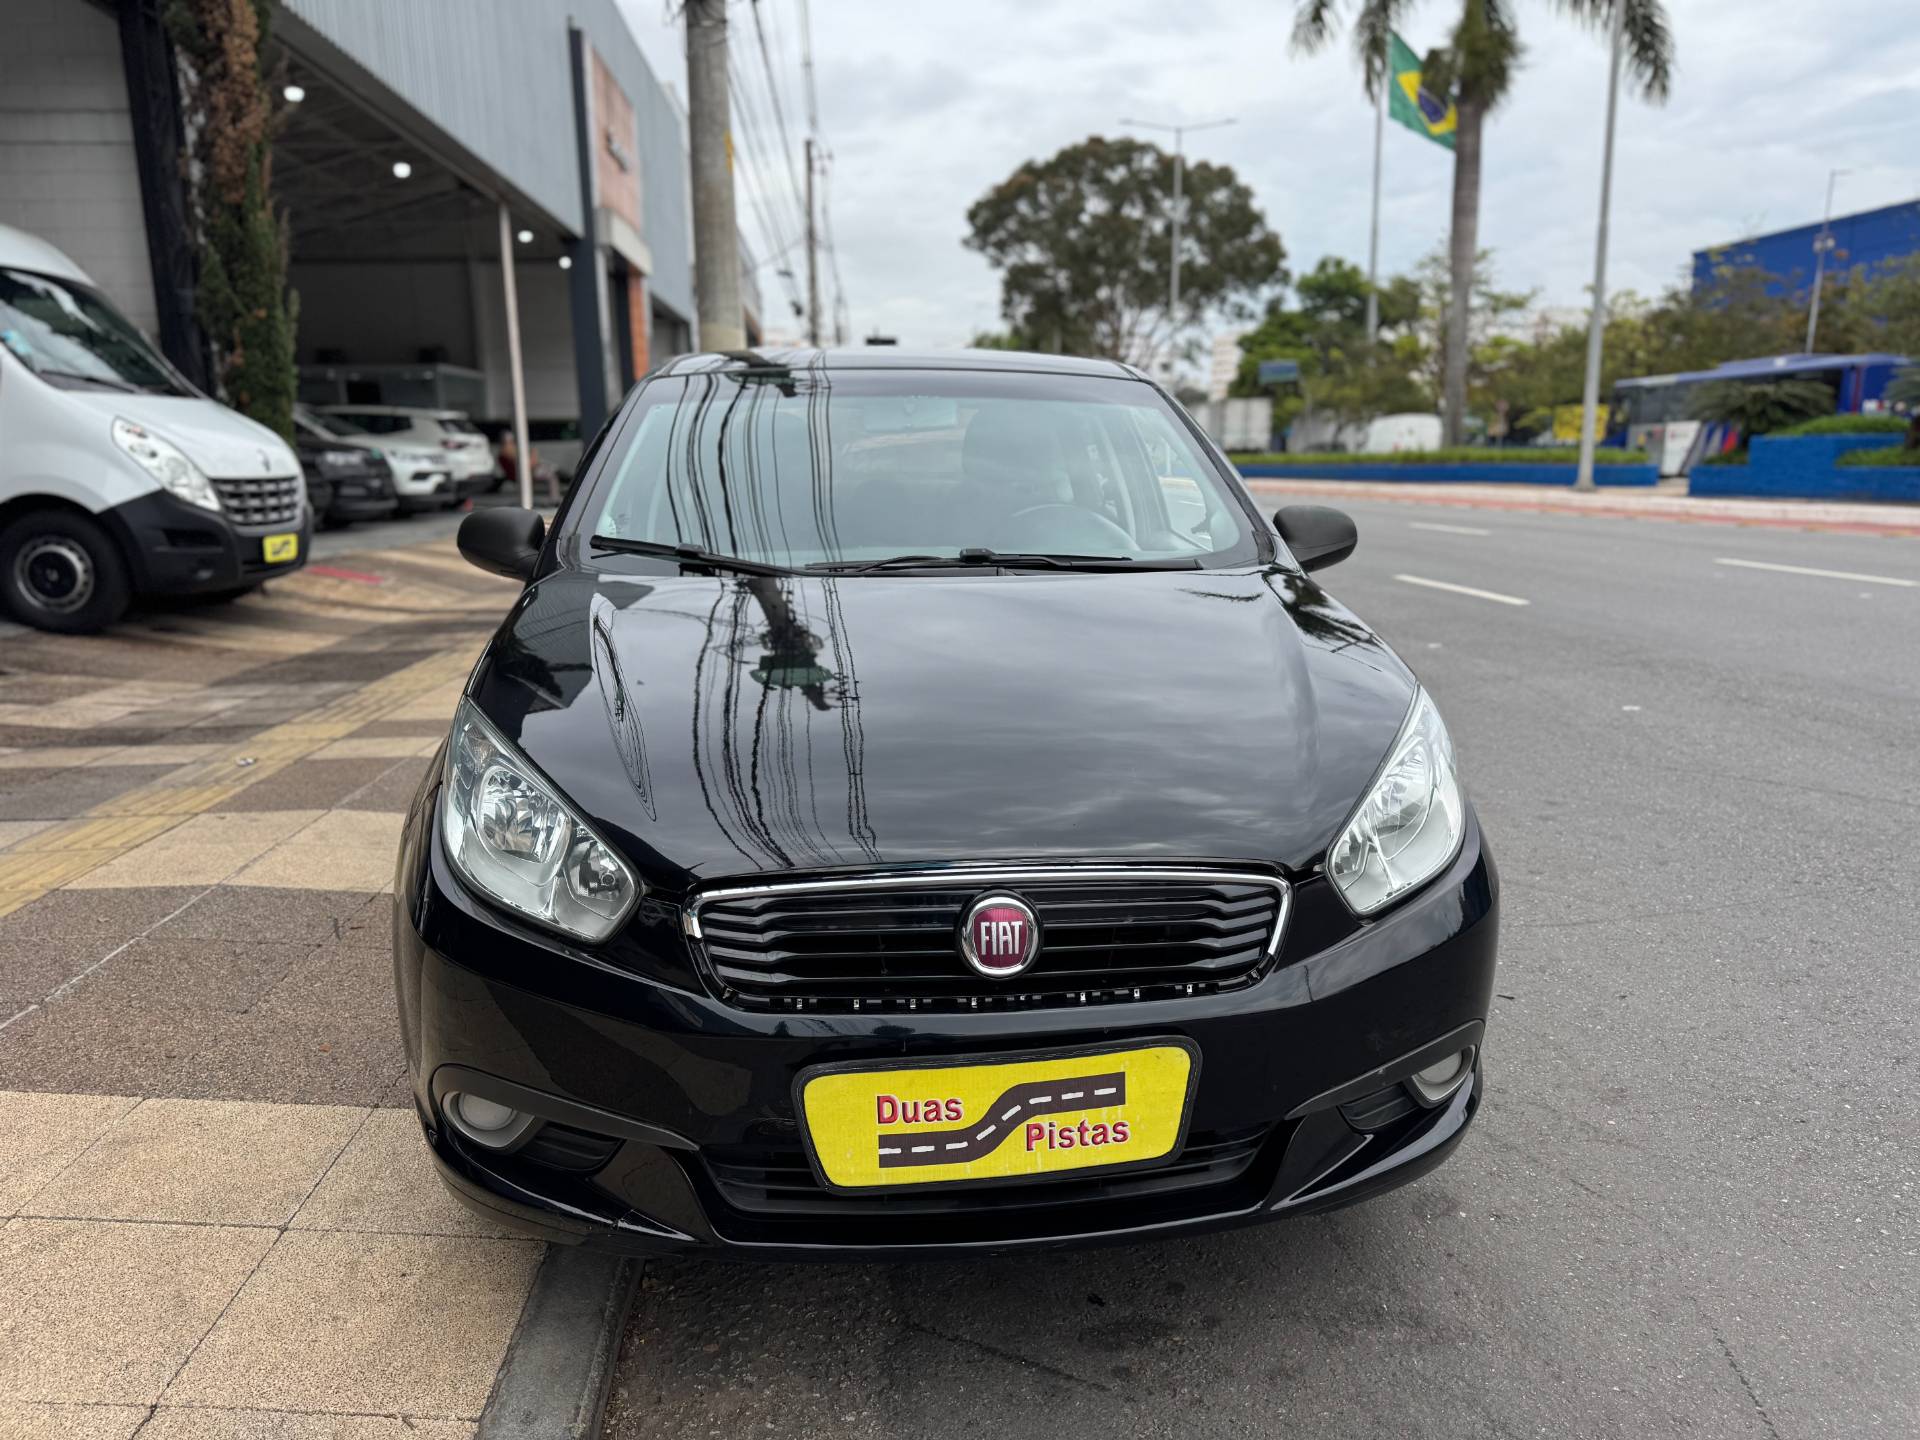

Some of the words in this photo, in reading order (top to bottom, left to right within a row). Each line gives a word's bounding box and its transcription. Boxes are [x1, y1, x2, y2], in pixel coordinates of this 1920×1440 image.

[980, 920, 1023, 956] FIAT
[876, 1095, 963, 1125] Duas
[1025, 1119, 1130, 1151] Pistas
